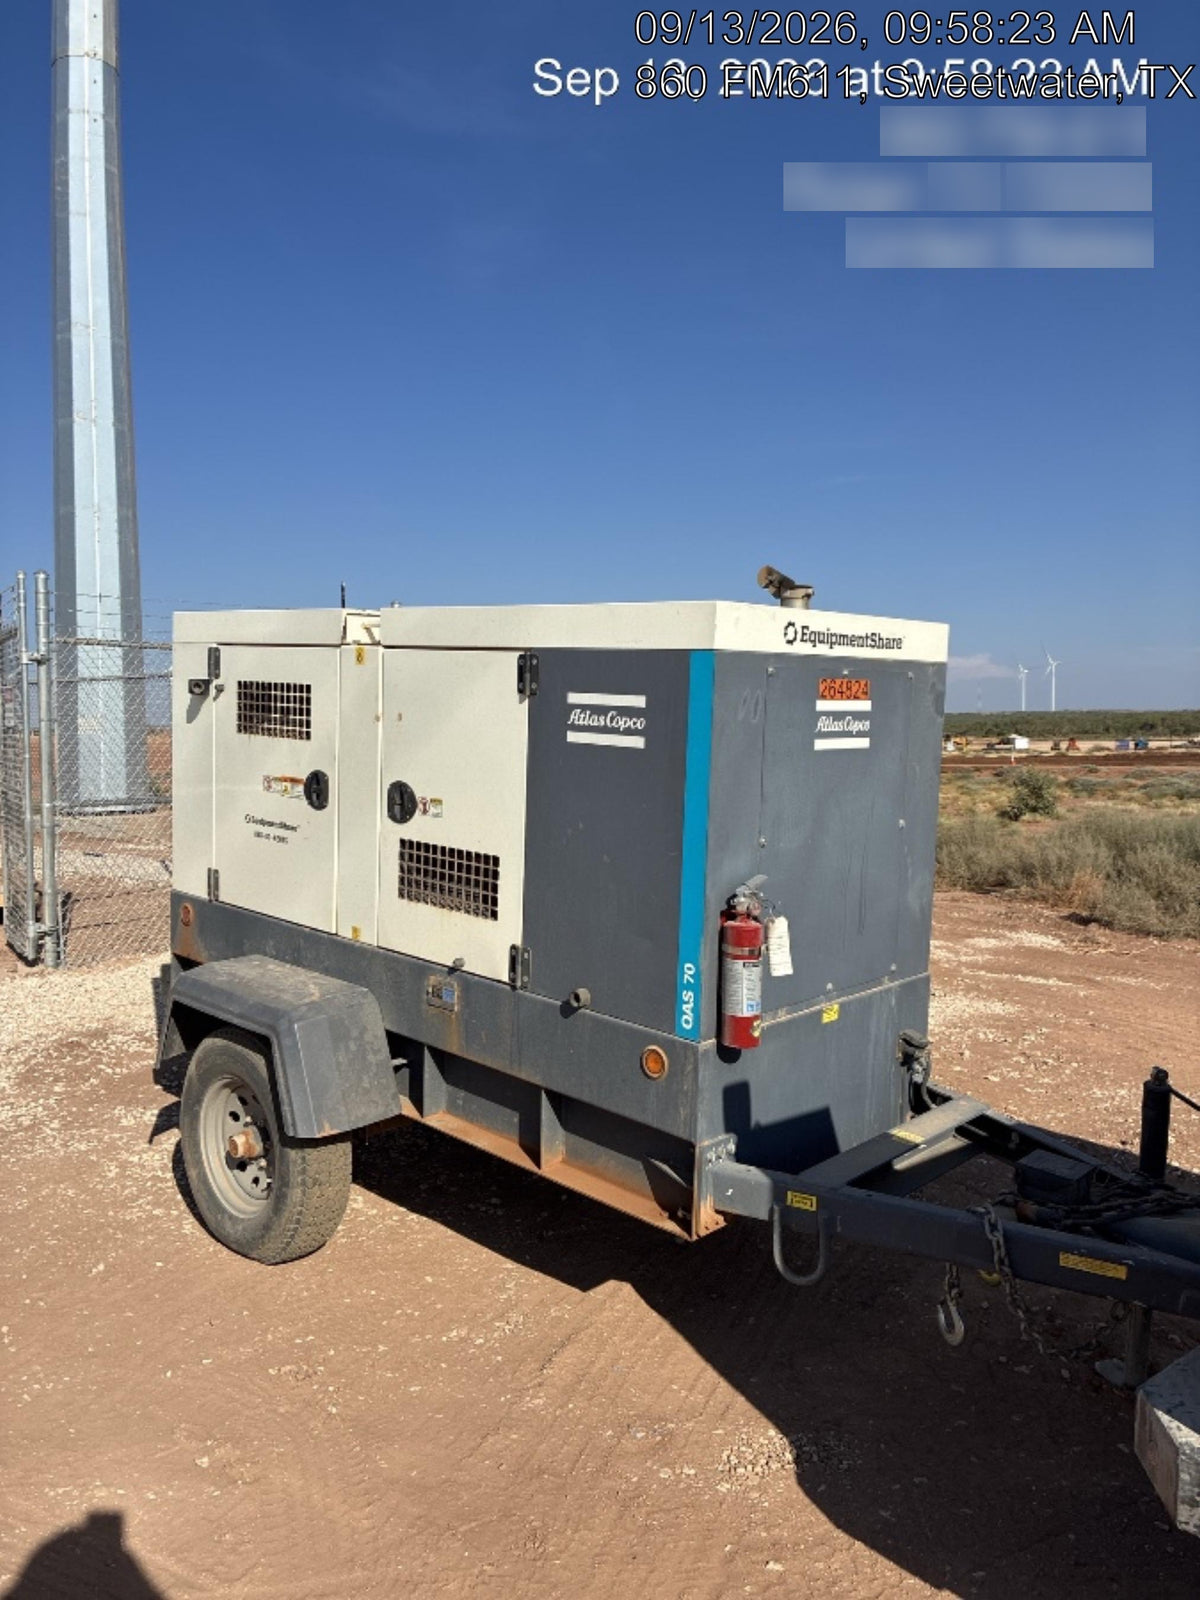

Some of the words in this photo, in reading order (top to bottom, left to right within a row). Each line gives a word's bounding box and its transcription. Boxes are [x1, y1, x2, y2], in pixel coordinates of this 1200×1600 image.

[800, 625, 903, 649] EquipmentShare
[567, 708, 605, 726] Atlas
[606, 710, 646, 732] Copco
[683, 963, 696, 984] 70
